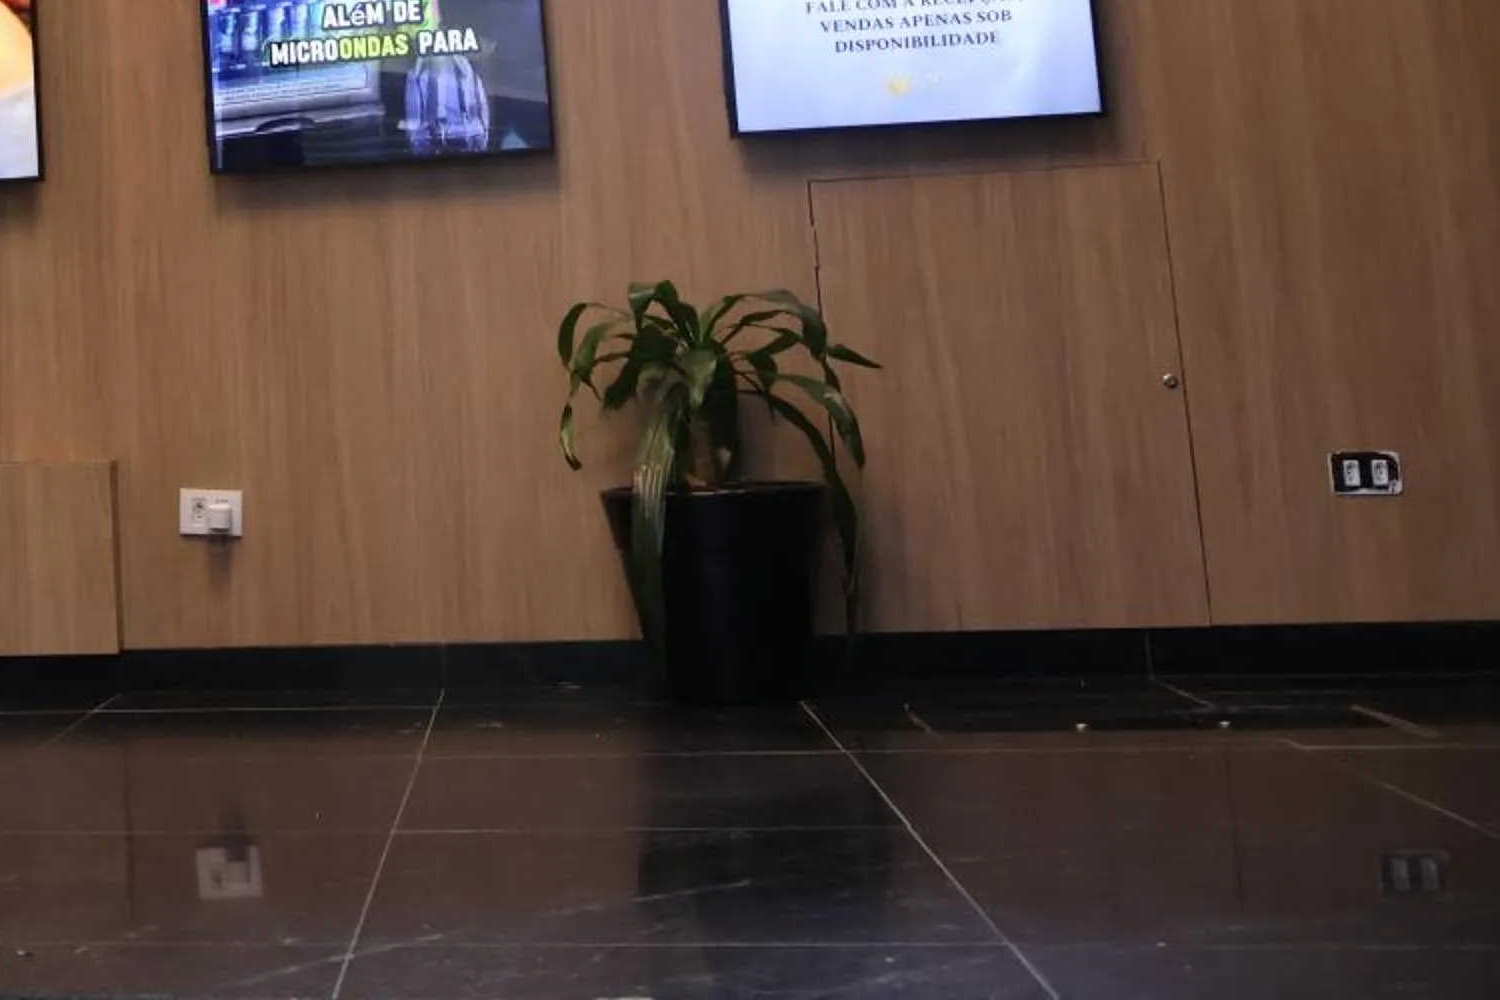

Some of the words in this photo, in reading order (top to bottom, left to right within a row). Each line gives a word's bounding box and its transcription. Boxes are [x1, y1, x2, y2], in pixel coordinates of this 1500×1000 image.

[393, 0, 421, 23] DE
[806, 0, 852, 14] FALE
[820, 16, 894, 32] VENDAS
[900, 12, 973, 29] APENAS
[977, 9, 1013, 23] SOB
[271, 35, 409, 65] MICROONDAS
[418, 27, 479, 54] PARA
[835, 31, 999, 53] DISPONIBILIDADE
